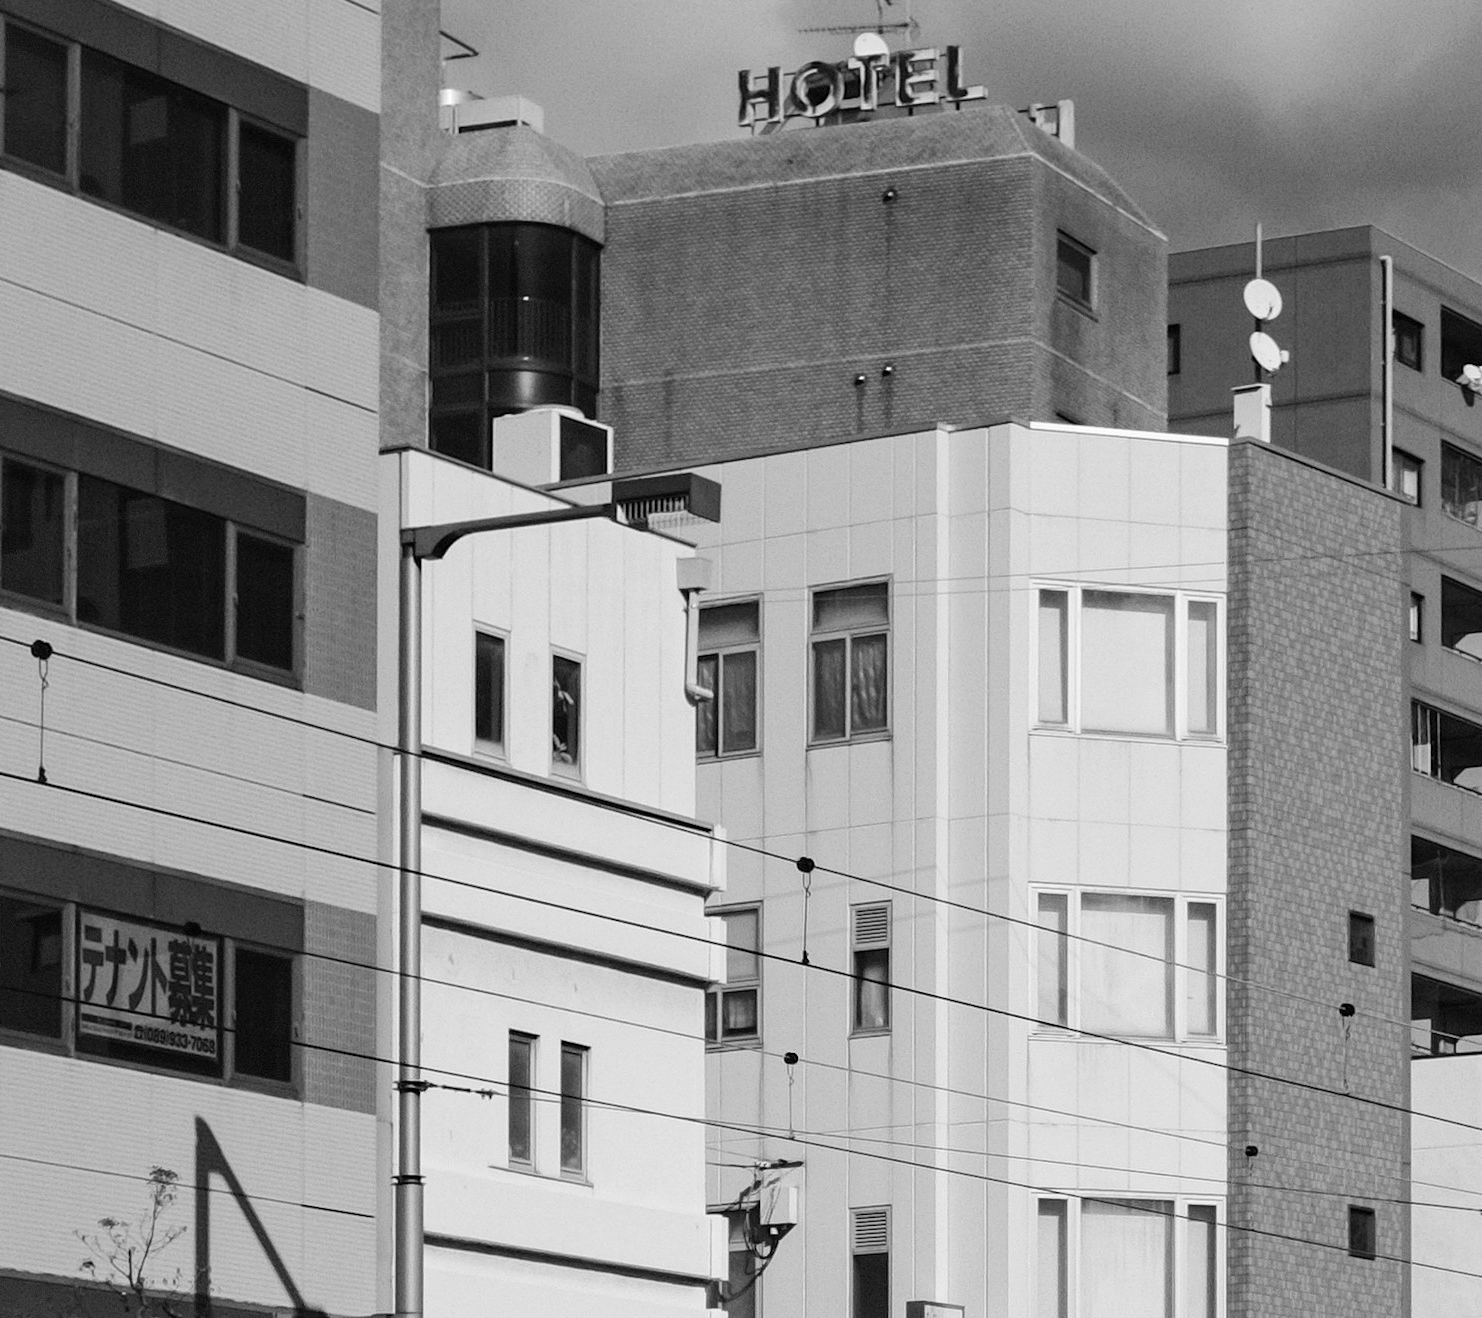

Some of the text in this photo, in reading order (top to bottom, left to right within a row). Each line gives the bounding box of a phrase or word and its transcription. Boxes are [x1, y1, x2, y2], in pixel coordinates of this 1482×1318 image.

[738, 44, 988, 127] HOTEL
[82, 922, 216, 1030] テナント募集
